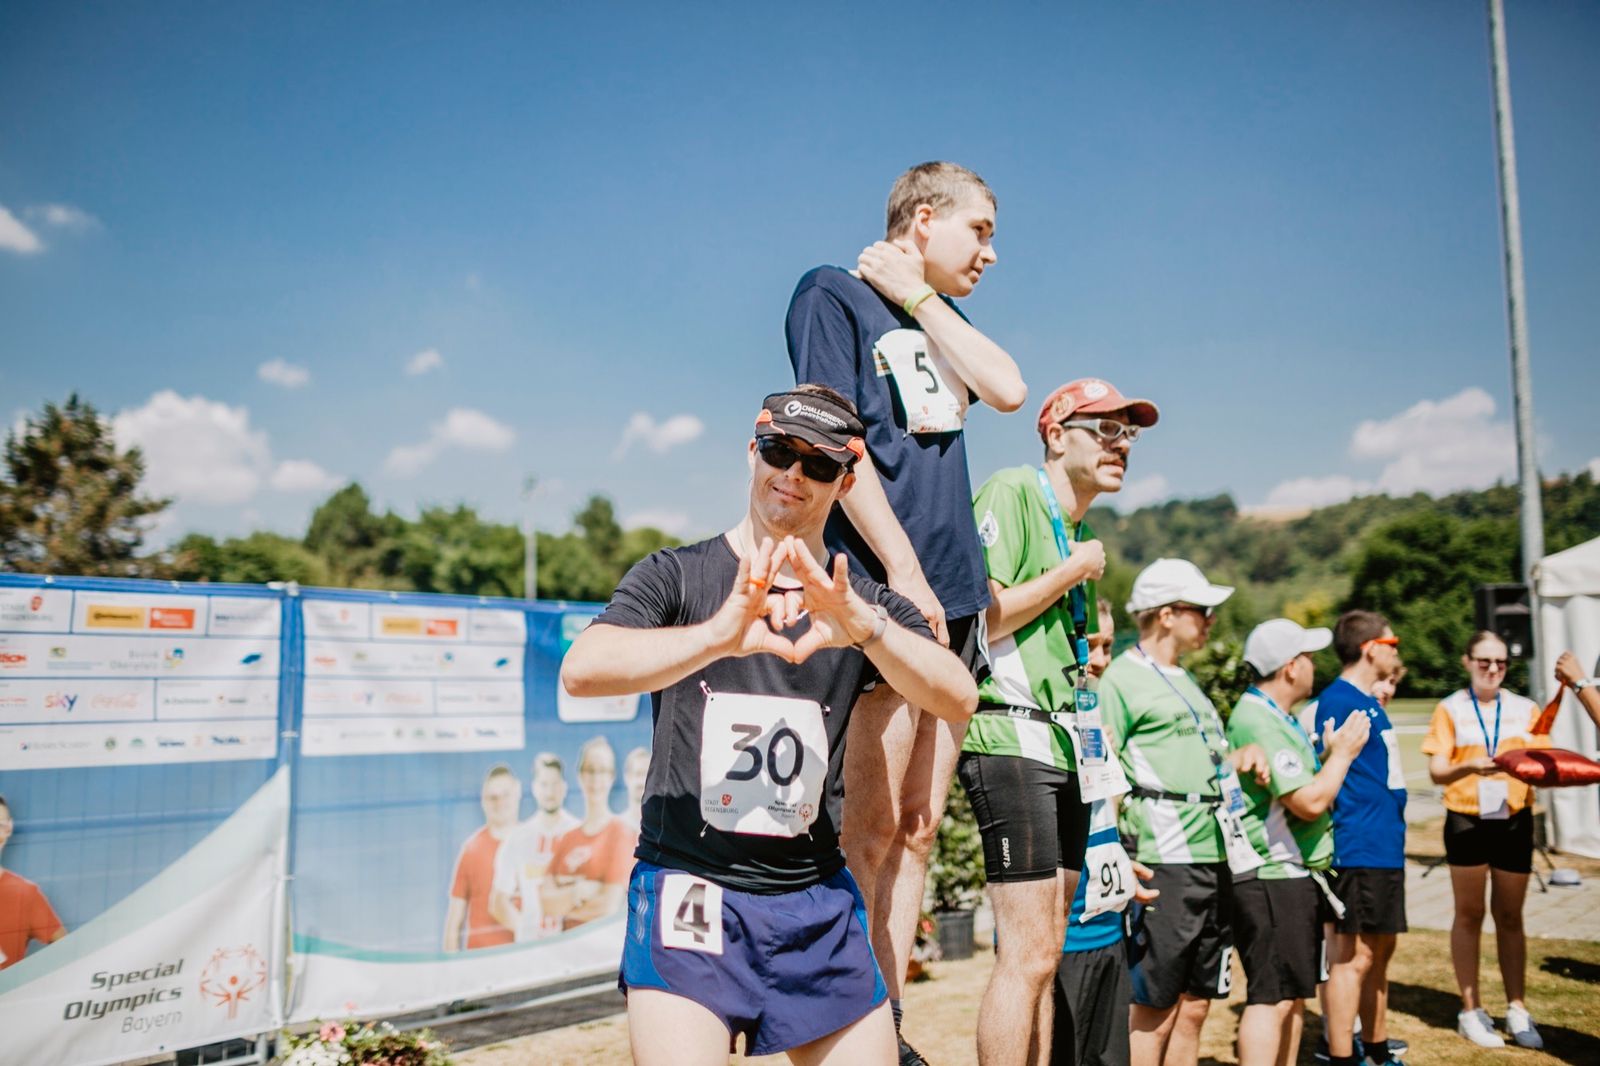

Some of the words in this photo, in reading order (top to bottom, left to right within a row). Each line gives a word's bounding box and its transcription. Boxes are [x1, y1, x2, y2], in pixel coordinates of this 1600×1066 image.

[914, 351, 939, 394] 5
[725, 722, 805, 787] 30
[1100, 860, 1126, 898] 91
[673, 882, 711, 944] 4
[90, 958, 185, 992] Special
[63, 986, 183, 1021] Olympics
[121, 1010, 183, 1034] Bayern
